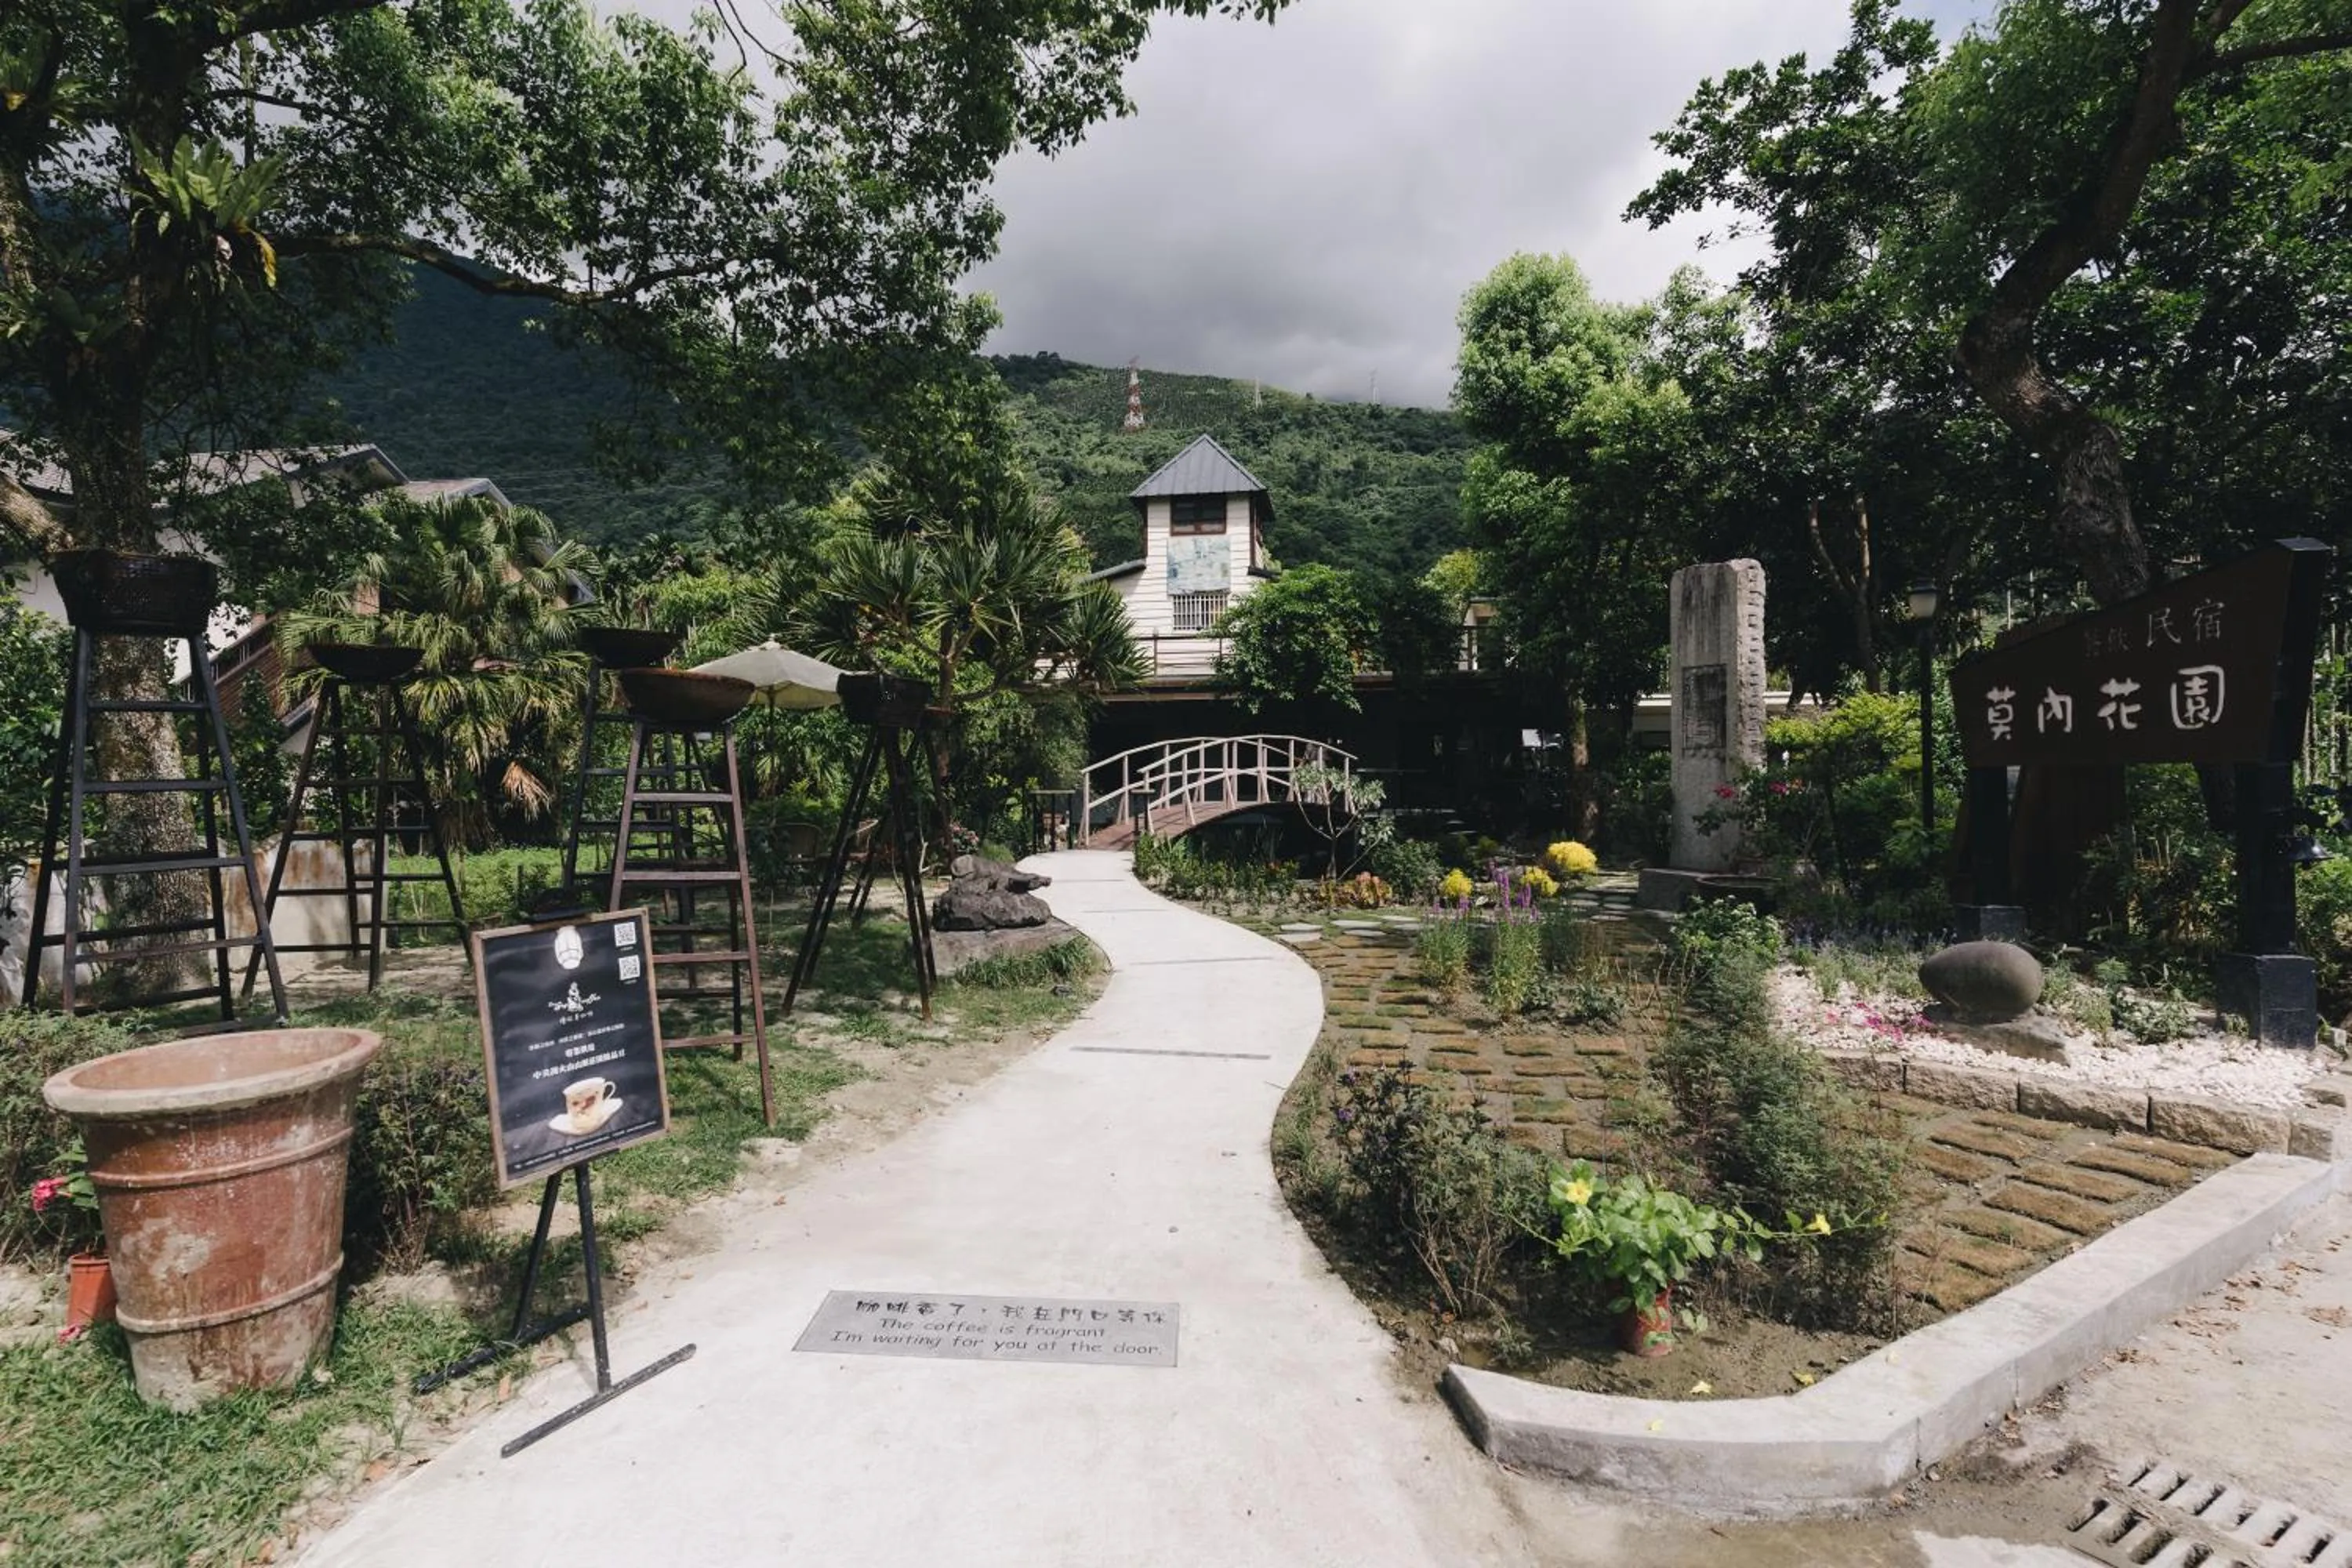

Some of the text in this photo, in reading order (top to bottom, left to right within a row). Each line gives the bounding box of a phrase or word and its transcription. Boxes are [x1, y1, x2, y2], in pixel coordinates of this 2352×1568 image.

[1987, 664, 2225, 740] 莫內花園
[880, 1318, 1105, 1338] The coffee is fragrant
[830, 1330, 862, 1343] I'm
[873, 1333, 942, 1348] waiting
[952, 1335, 984, 1348] for
[993, 1341, 1028, 1353] you
[1036, 1341, 1057, 1351] at
[1071, 1341, 1102, 1352] the
